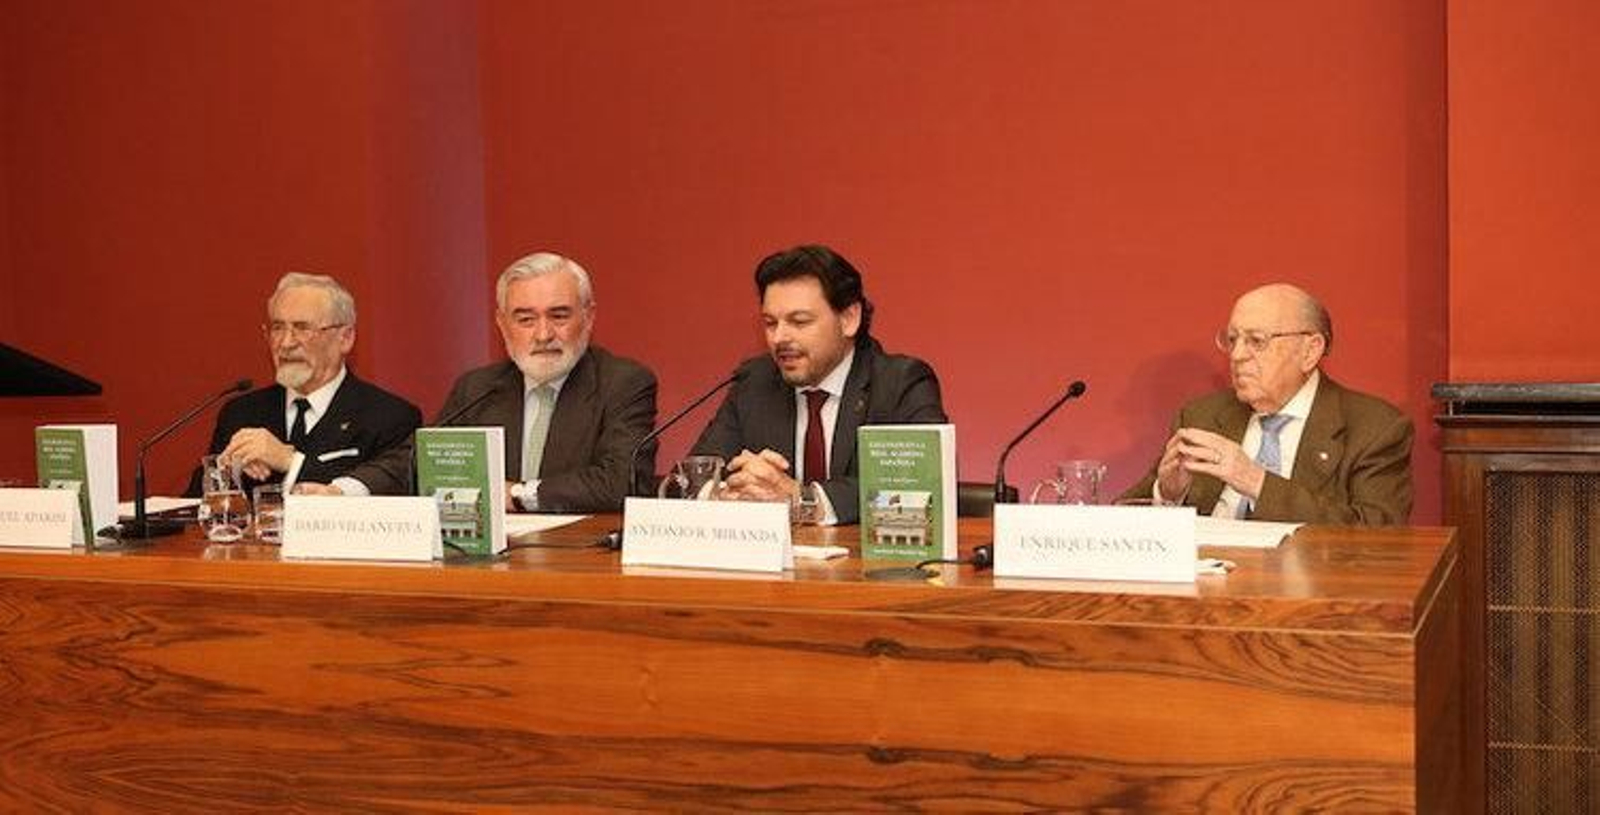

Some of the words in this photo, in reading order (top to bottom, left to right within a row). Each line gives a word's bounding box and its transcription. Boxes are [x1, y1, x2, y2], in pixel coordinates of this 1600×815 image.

[337, 519, 422, 534] VILLANUEVA
[631, 523, 694, 538] ANTONIO
[712, 527, 780, 543] MIRANDA
[1020, 535, 1096, 552] ENRIQUE
